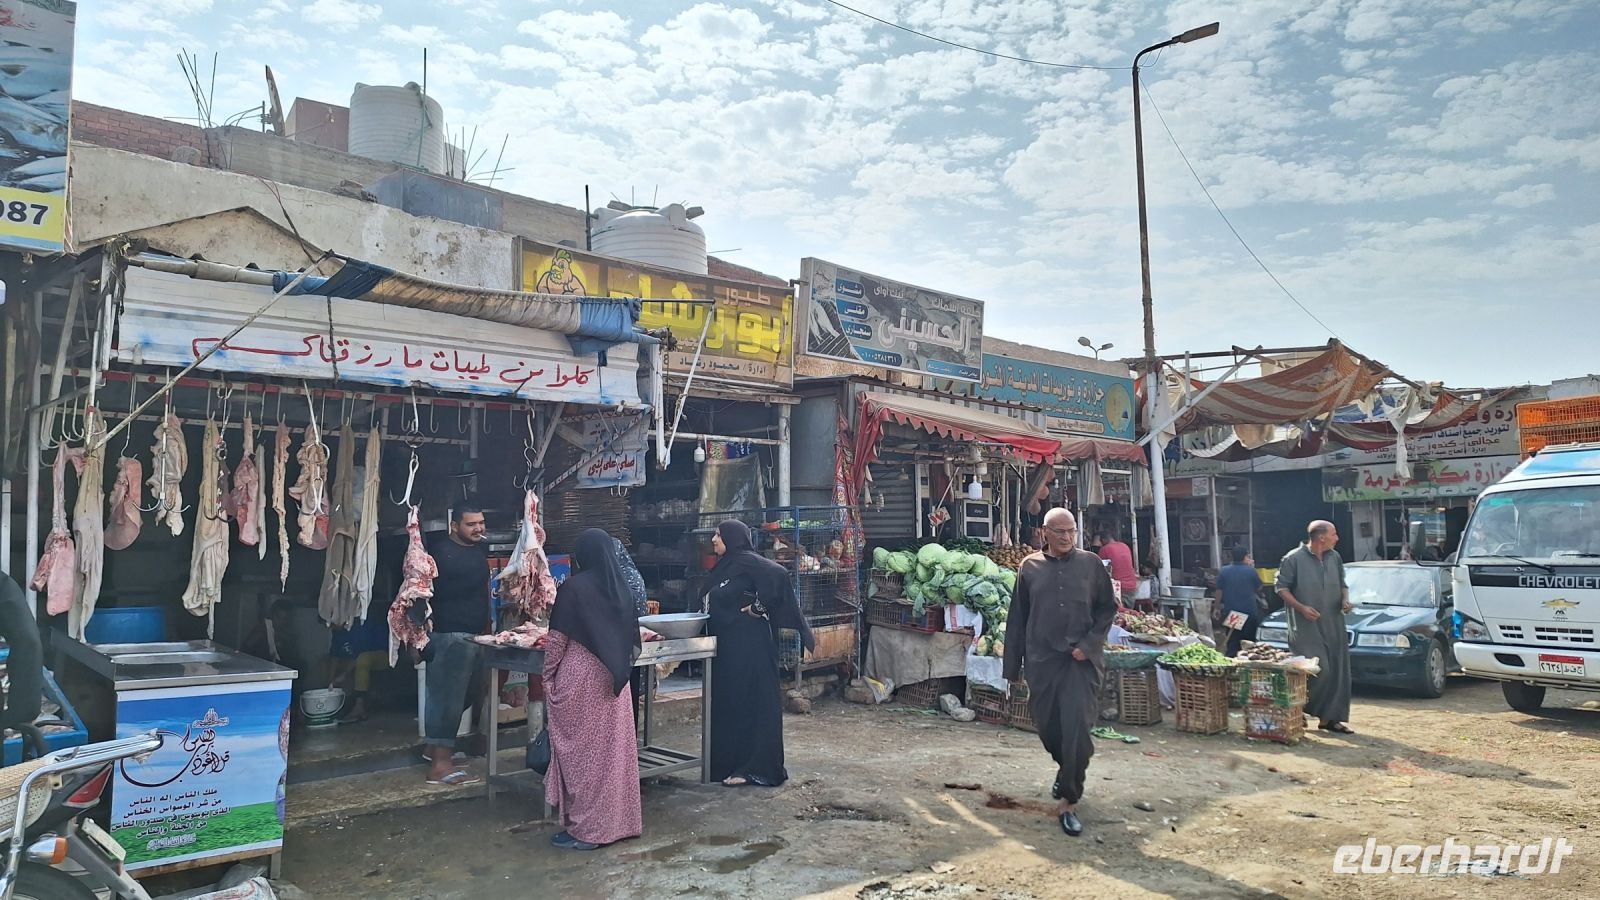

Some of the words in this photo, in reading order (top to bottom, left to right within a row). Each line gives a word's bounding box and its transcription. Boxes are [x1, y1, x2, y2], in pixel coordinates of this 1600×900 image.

[0, 200, 49, 225] 87
[722, 285, 771, 308] طيور
[608, 274, 726, 349] رشا
[931, 297, 958, 313] اسماك
[429, 350, 491, 380] طيبات
[499, 361, 544, 383] من
[708, 359, 740, 371] محمود
[546, 363, 595, 388] كلوا
[979, 363, 1006, 390] المنور
[1008, 365, 1041, 398] المدينة
[1083, 377, 1105, 405] جزارة
[1462, 428, 1482, 440] جميع
[1519, 575, 1600, 589] CHEVROLET
[1540, 662, 1562, 674] ٢٦٣٤
[129, 796, 156, 808] الناس
[174, 790, 200, 801] الناس
[123, 806, 156, 819] الخناس
[159, 801, 194, 814] الوسواس
[110, 820, 138, 832] الناس
